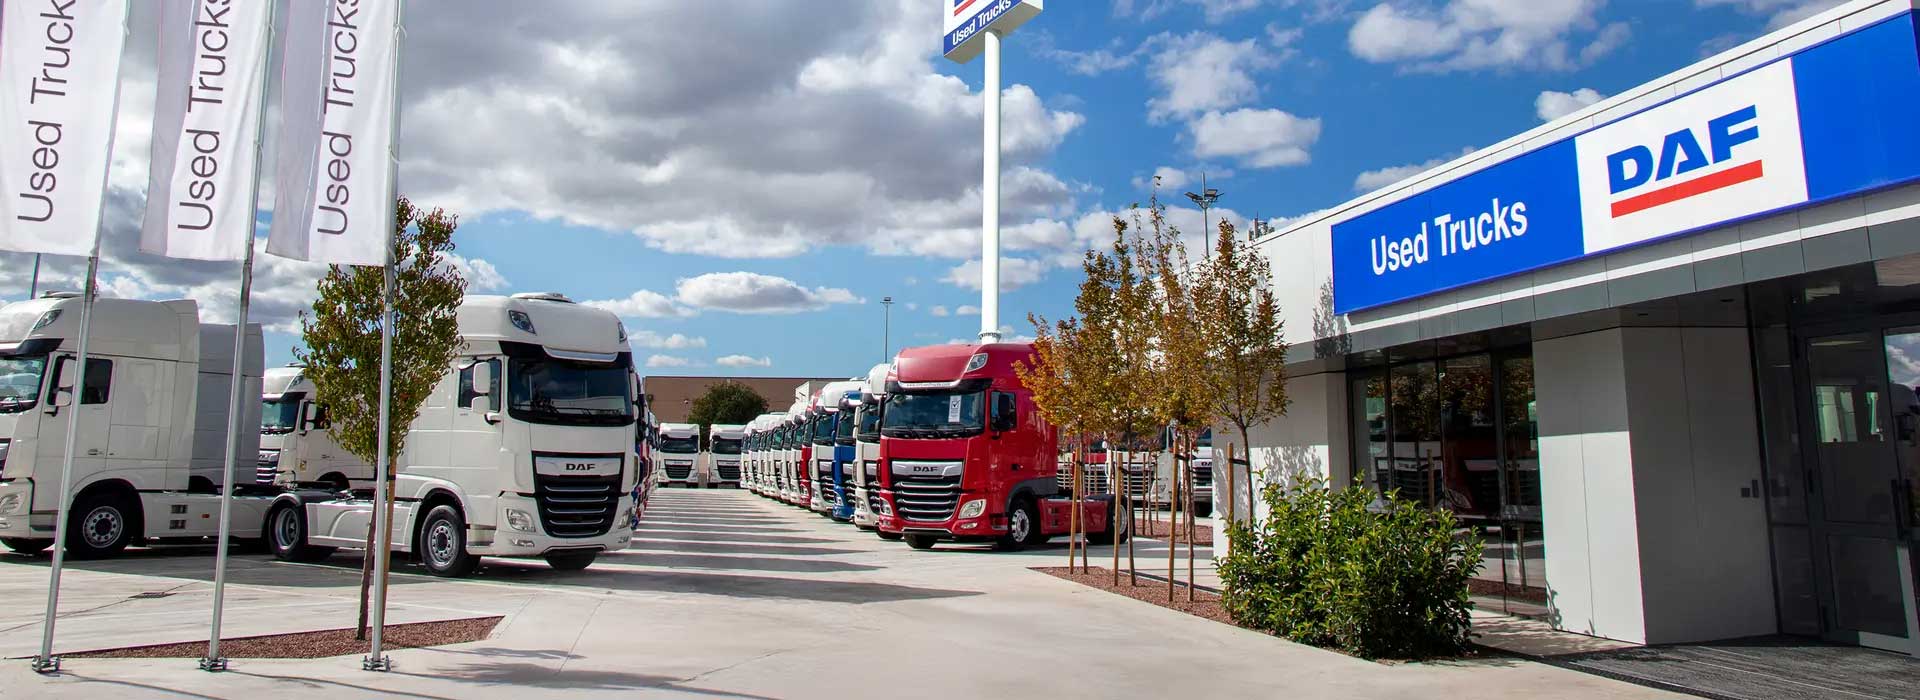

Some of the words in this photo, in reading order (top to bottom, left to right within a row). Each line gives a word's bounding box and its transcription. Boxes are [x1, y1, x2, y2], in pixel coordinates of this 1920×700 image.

[952, 18, 976, 46] Used
[978, 0, 1012, 28] Trucks
[17, 120, 63, 222] Used
[177, 129, 220, 231] Used
[317, 131, 352, 235] Used
[1606, 104, 1760, 195] DAF
[1371, 220, 1429, 276] Used
[1435, 197, 1528, 256] Trucks
[566, 463, 595, 471] DAF
